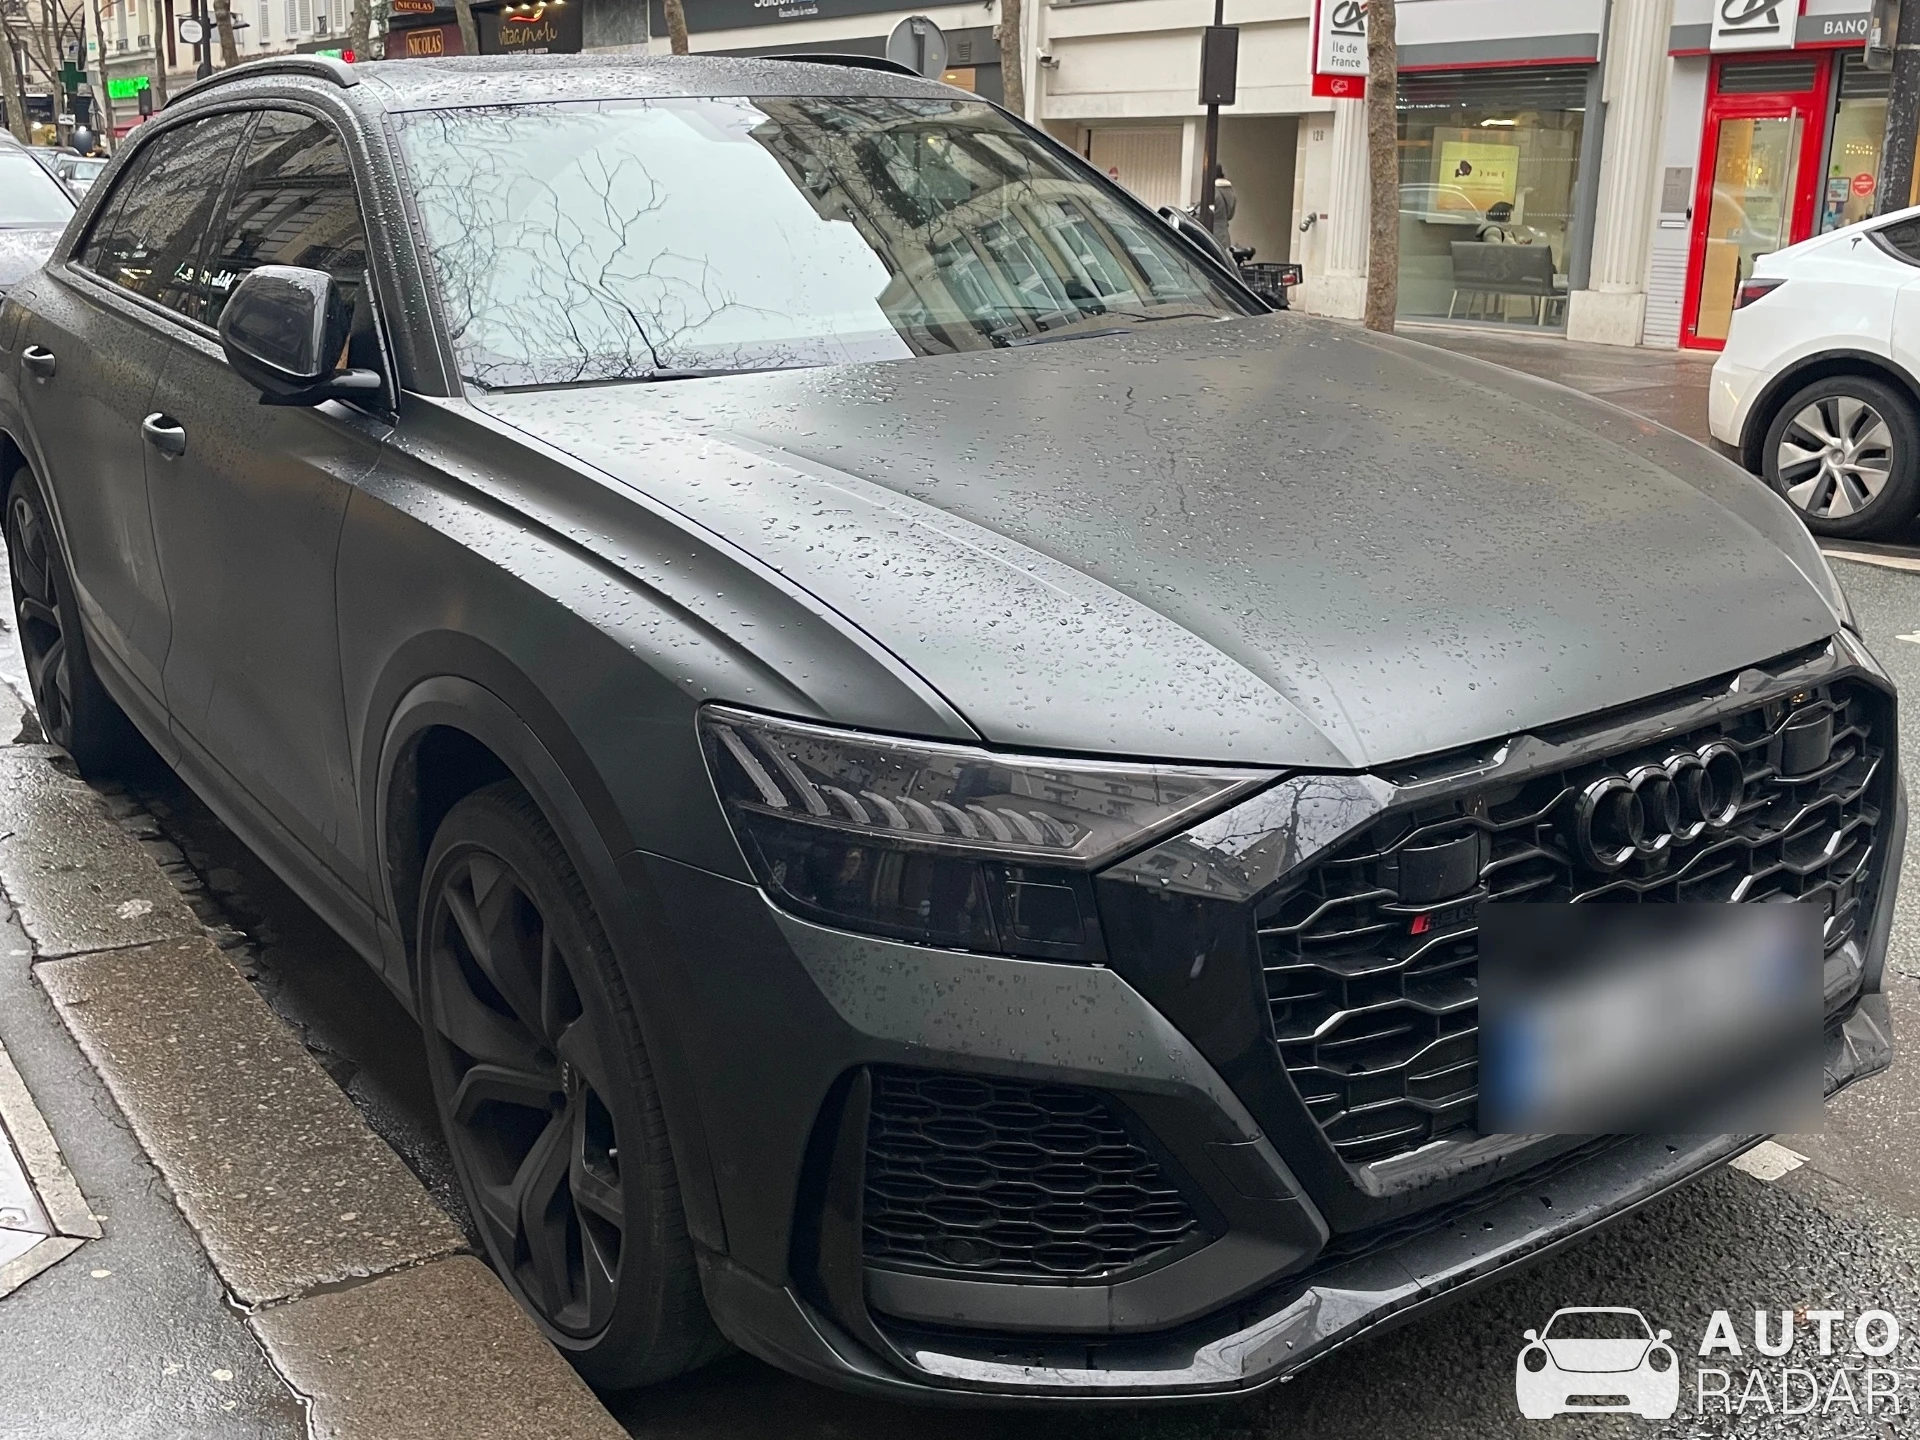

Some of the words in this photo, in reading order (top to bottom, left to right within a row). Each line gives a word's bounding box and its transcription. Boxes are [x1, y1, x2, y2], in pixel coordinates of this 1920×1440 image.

[397, 1, 432, 11] NICOLAS
[408, 35, 442, 56] NICOLAS
[1346, 43, 1358, 54] de
[1331, 55, 1361, 67] France
